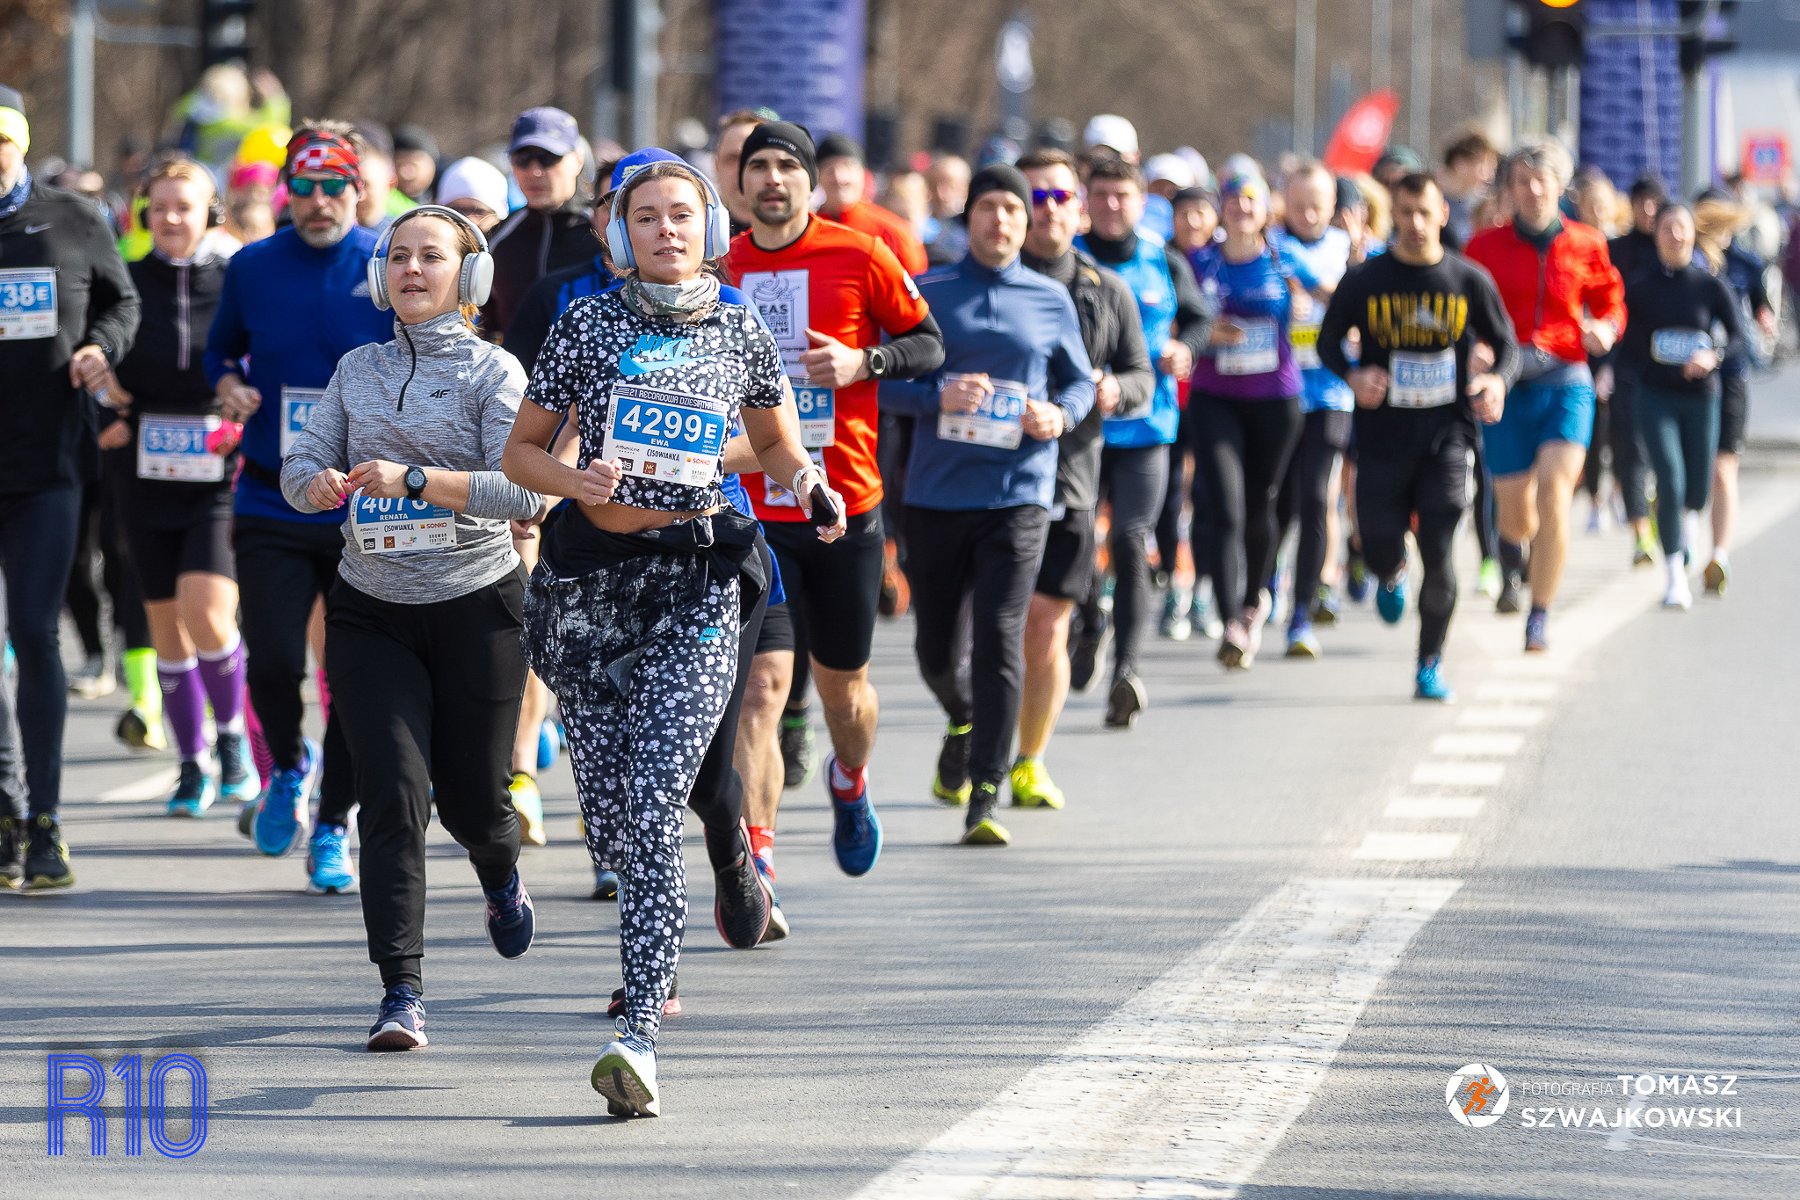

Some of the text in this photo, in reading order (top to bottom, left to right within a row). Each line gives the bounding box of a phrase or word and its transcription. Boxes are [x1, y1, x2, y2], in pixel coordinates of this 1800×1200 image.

[632, 335, 693, 358] NIKE
[430, 389, 451, 399] 4F
[629, 388, 638, 397] 21
[639, 390, 678, 404] RECORDOWA
[650, 438, 670, 448] EWA
[646, 448, 680, 462] CISOWIANKA
[379, 513, 409, 521] RENATA
[384, 524, 415, 533] CISOWIANKA
